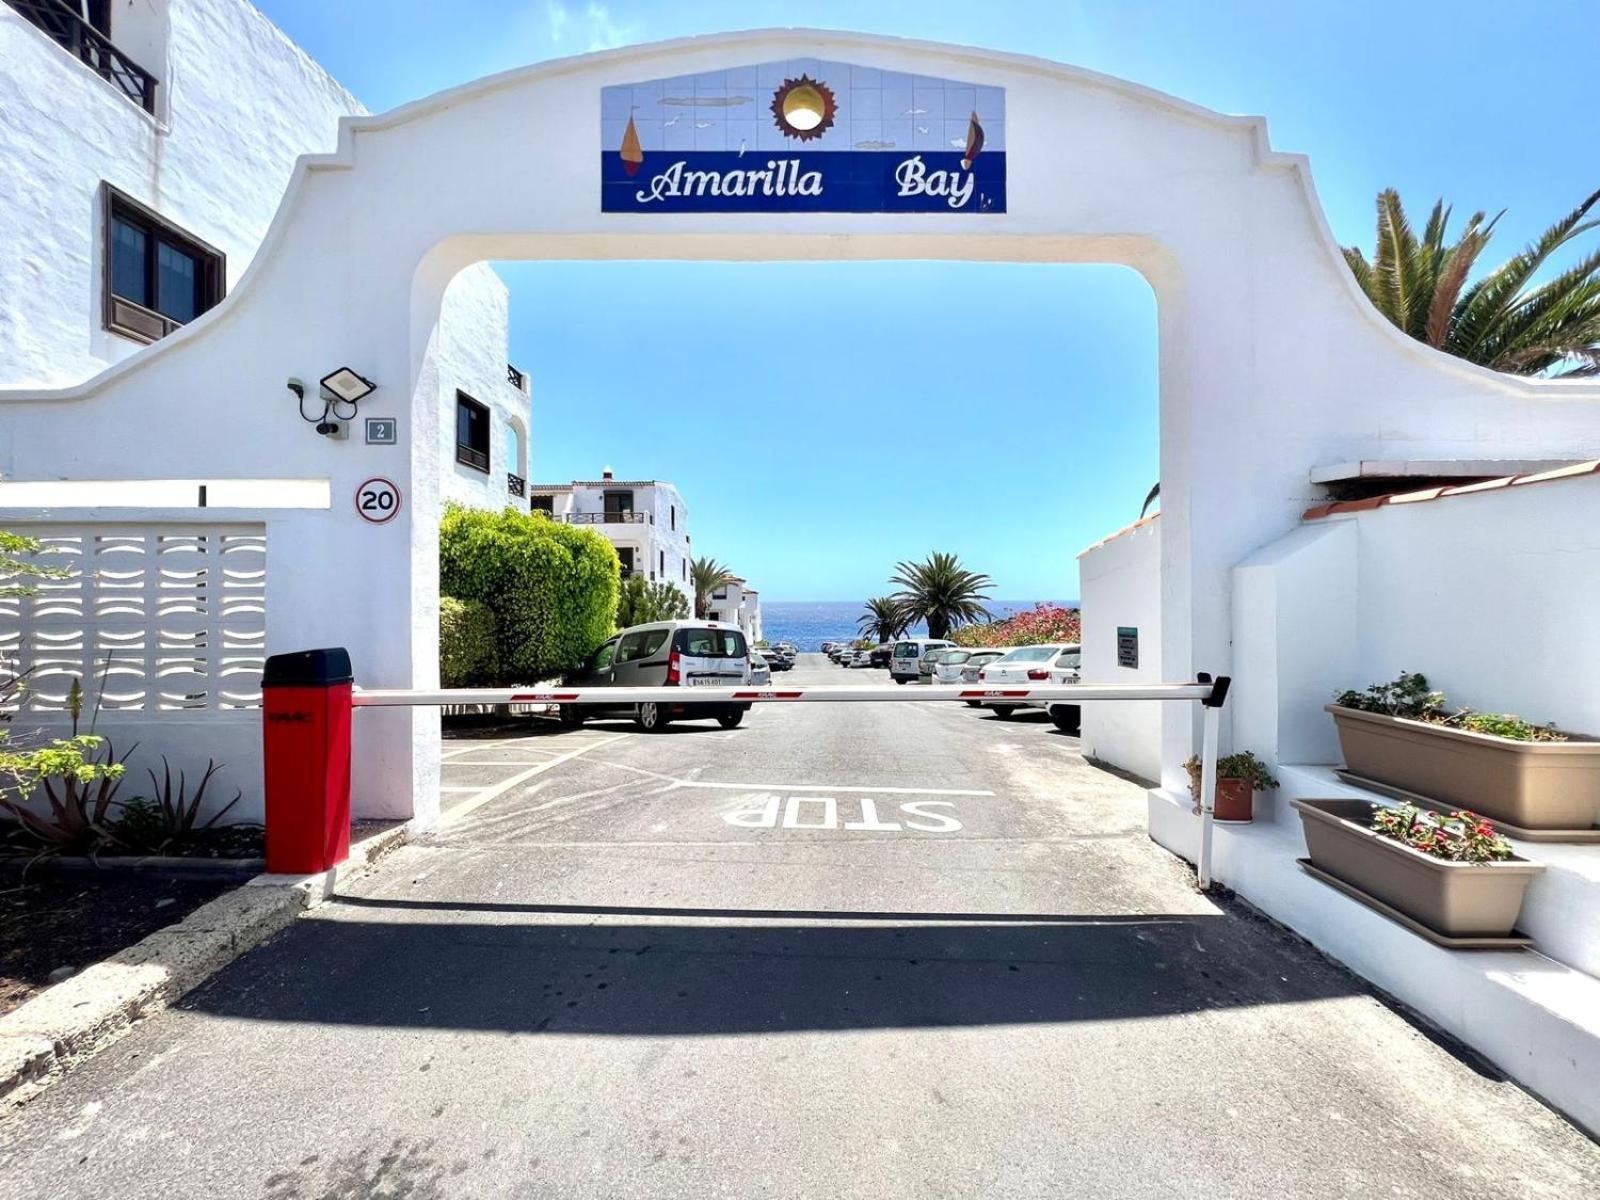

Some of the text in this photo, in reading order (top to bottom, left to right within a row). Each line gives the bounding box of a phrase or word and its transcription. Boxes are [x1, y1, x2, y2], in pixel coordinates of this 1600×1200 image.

[636, 155, 975, 209] Amarilla Bay
[376, 424, 386, 438] 2
[362, 490, 394, 511] 20
[719, 792, 964, 833] STOP
